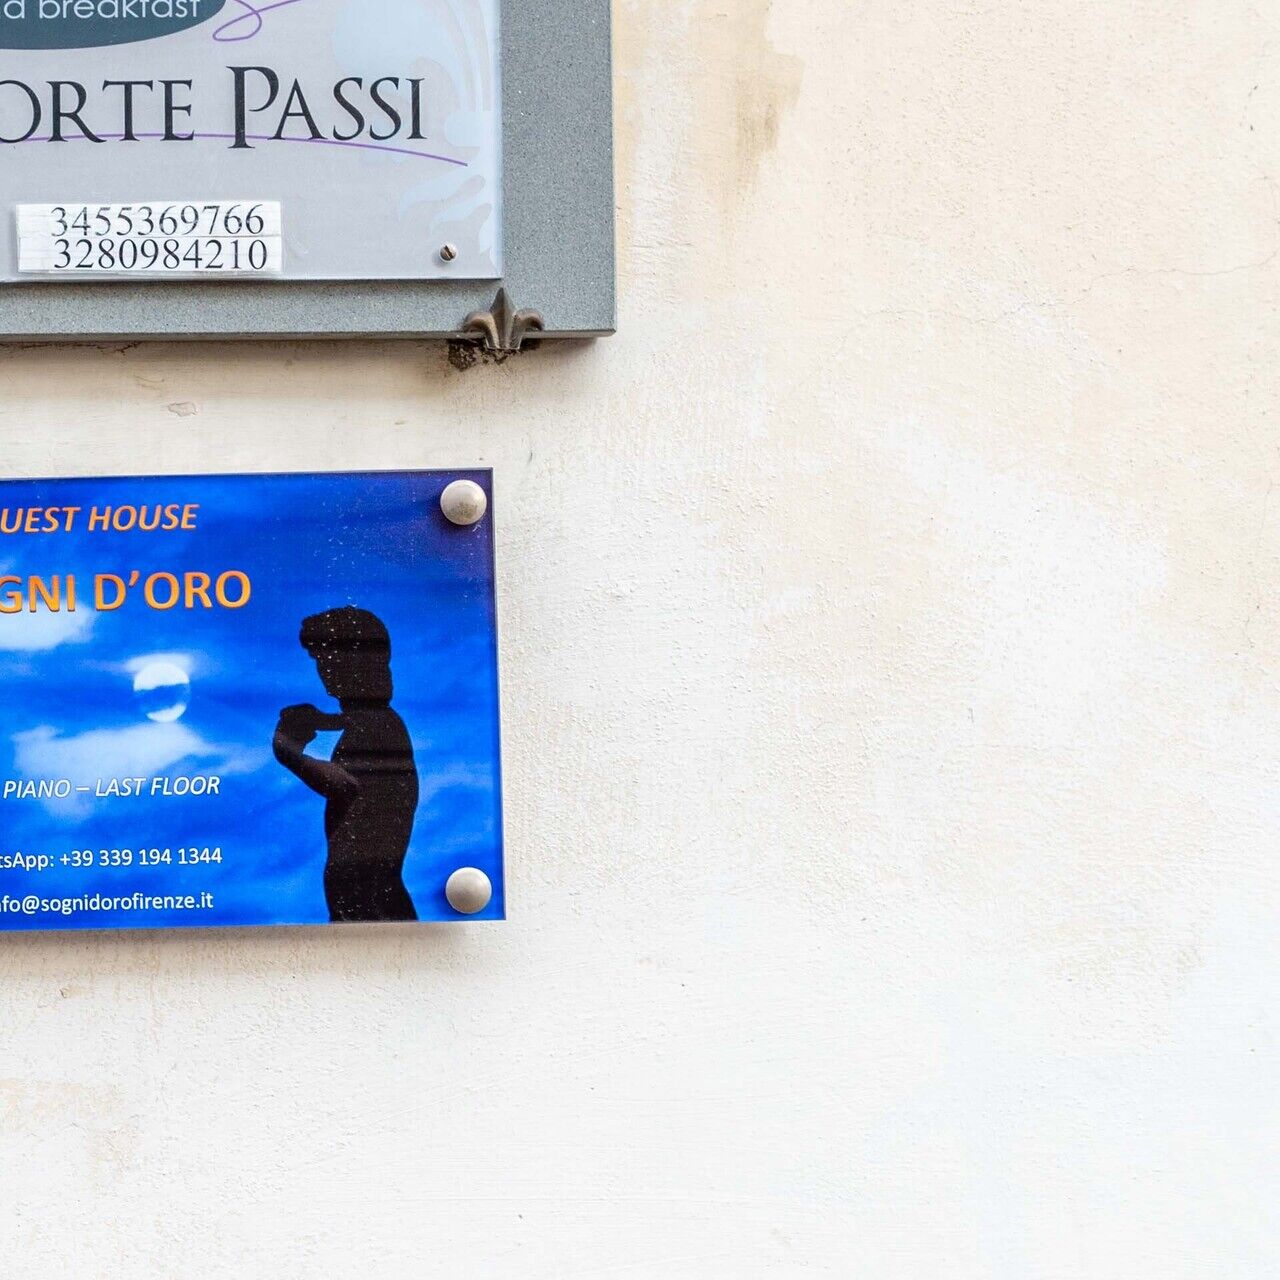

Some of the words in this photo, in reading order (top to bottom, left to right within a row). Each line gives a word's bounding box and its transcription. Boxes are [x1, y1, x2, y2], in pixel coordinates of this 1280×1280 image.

[225, 65, 428, 149] PASSI
[50, 204, 265, 237] 3455369766
[53, 238, 268, 270] 3280984210
[88, 504, 200, 531] HOUSE
[3, 778, 70, 799] PIANO
[95, 777, 146, 797] LAST
[150, 776, 221, 796] FLOOR
[59, 849, 94, 867] +39
[99, 849, 133, 866] 339
[138, 848, 172, 865] 194
[177, 847, 223, 864] 1344
